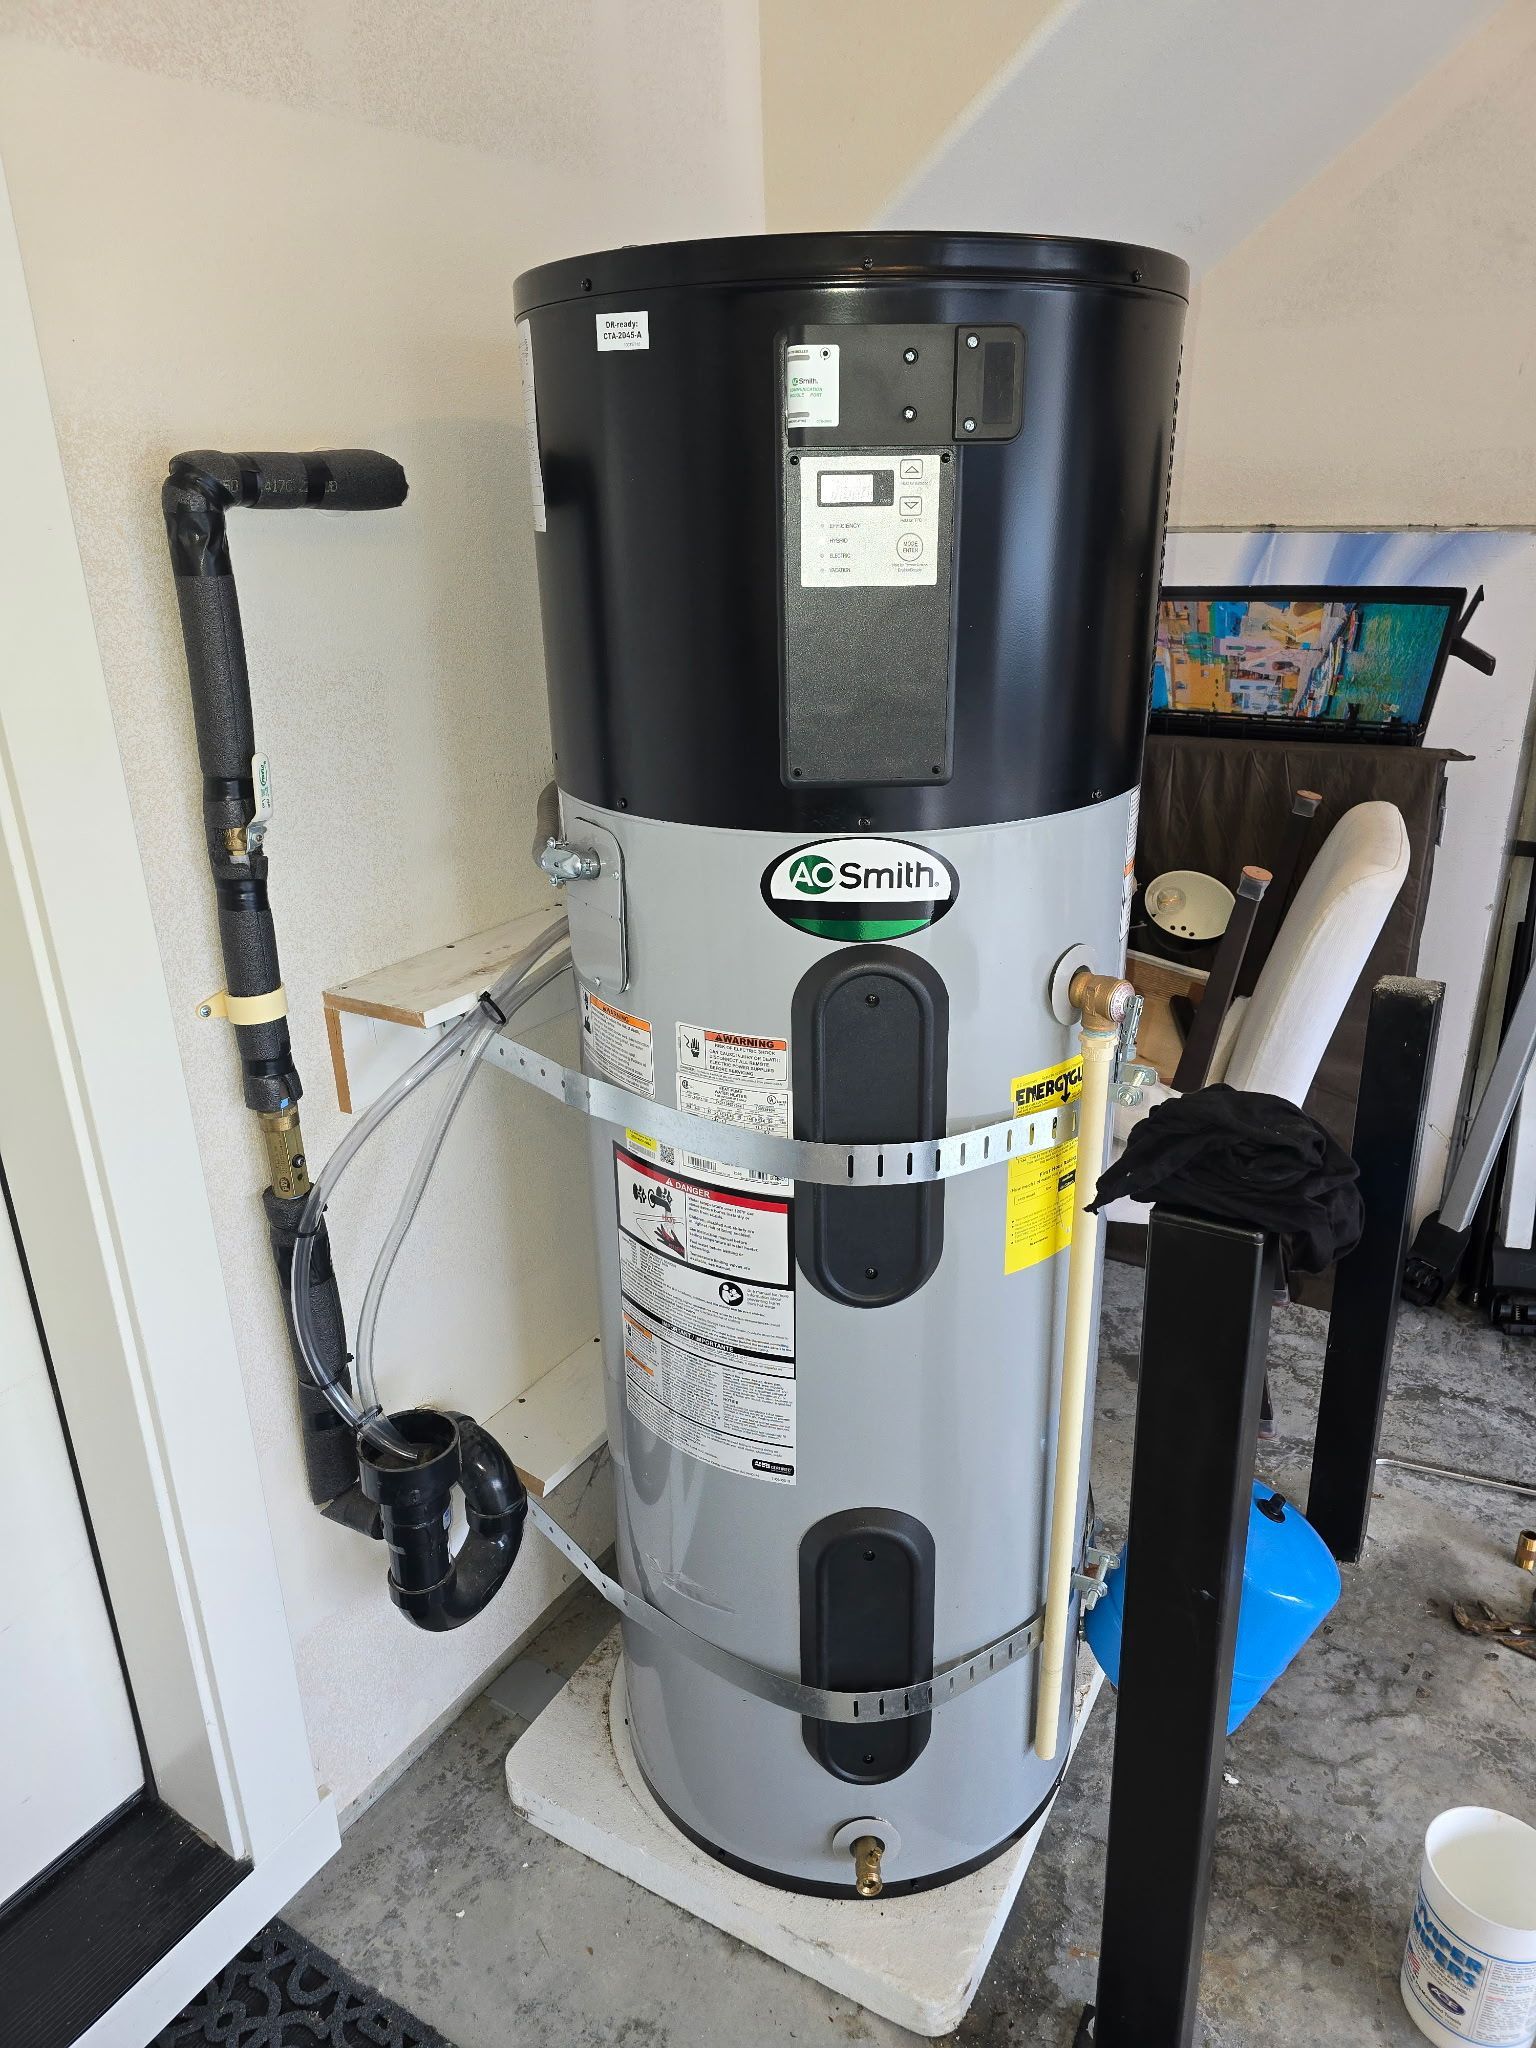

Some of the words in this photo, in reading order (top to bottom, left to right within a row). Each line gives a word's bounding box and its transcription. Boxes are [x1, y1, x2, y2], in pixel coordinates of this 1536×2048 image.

[605, 320, 638, 330] DR-ready:
[603, 331, 642, 340] CTA-2045-A
[723, 1035, 775, 1049] WARNING
[675, 1182, 711, 1199] DANGER
